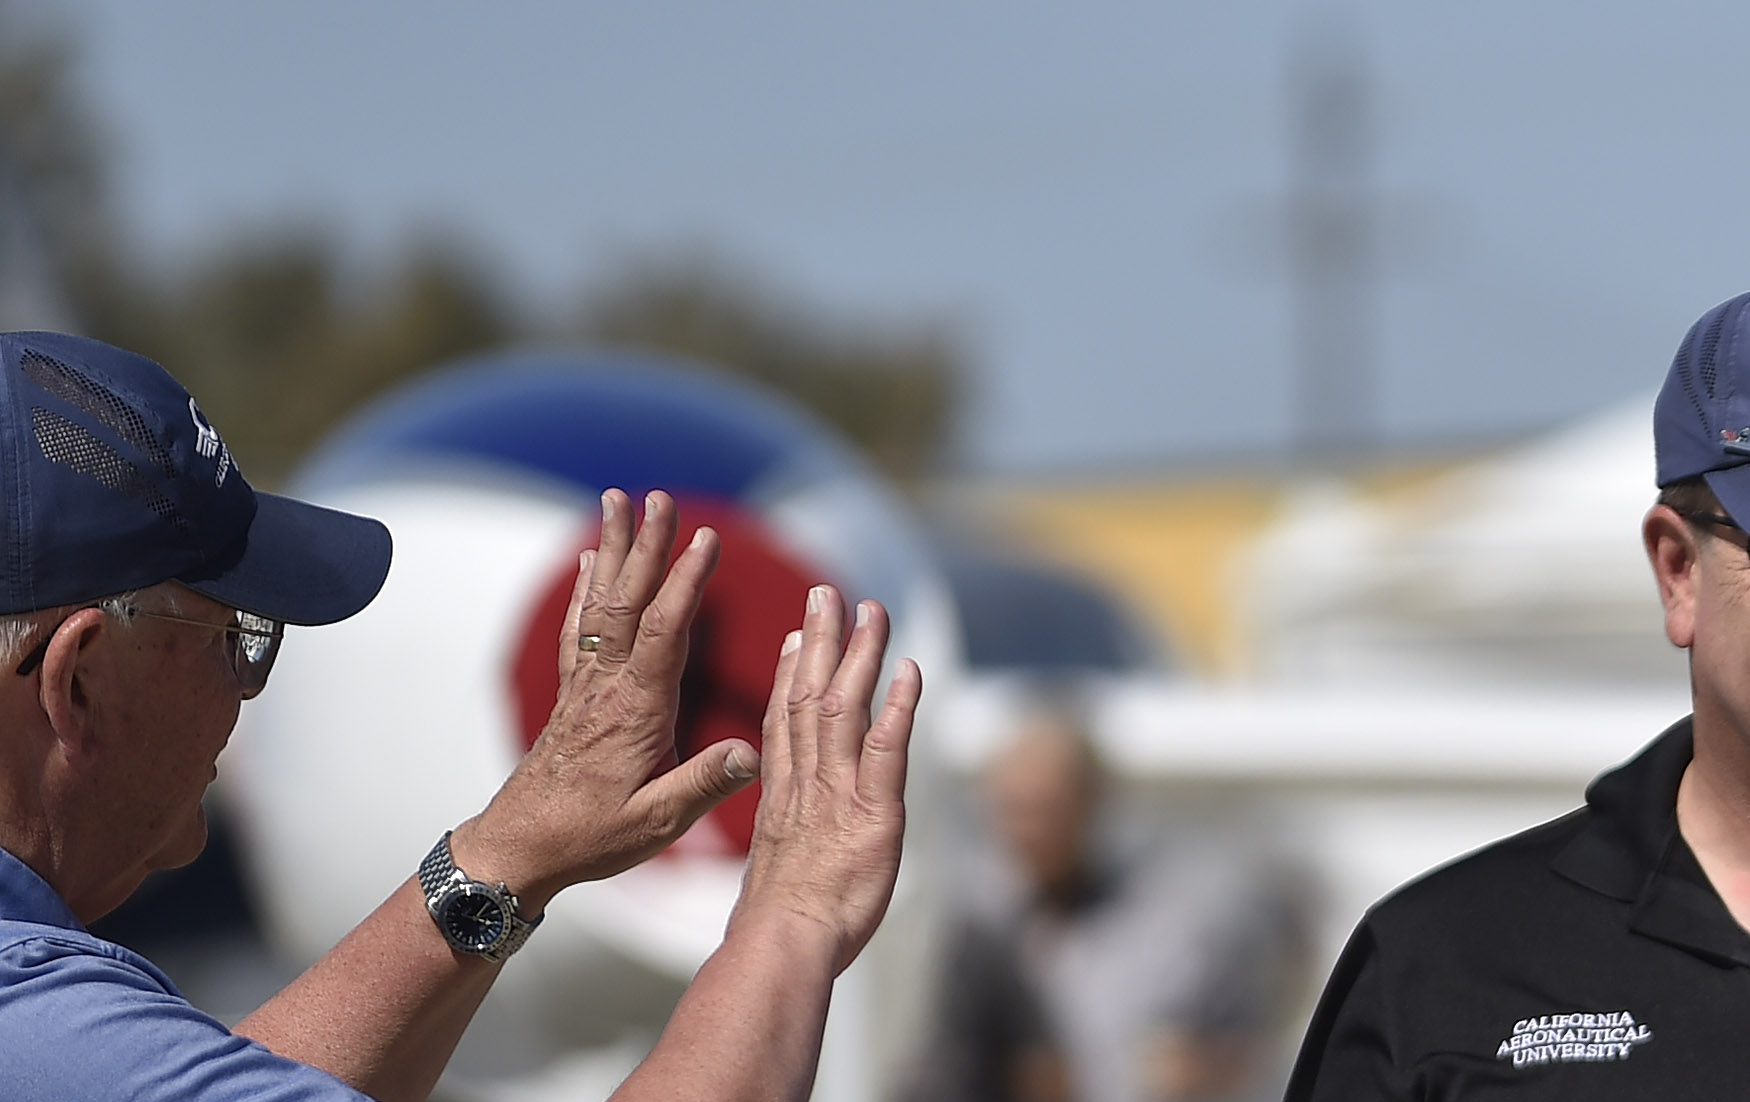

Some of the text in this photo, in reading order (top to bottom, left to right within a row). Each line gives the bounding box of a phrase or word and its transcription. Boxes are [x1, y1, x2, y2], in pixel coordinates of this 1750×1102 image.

[1512, 1010, 1634, 1035] CALIFORNIA
[1495, 1024, 1652, 1059] AERONAUTICAL
[1512, 1042, 1632, 1069] UNIVERSITY
